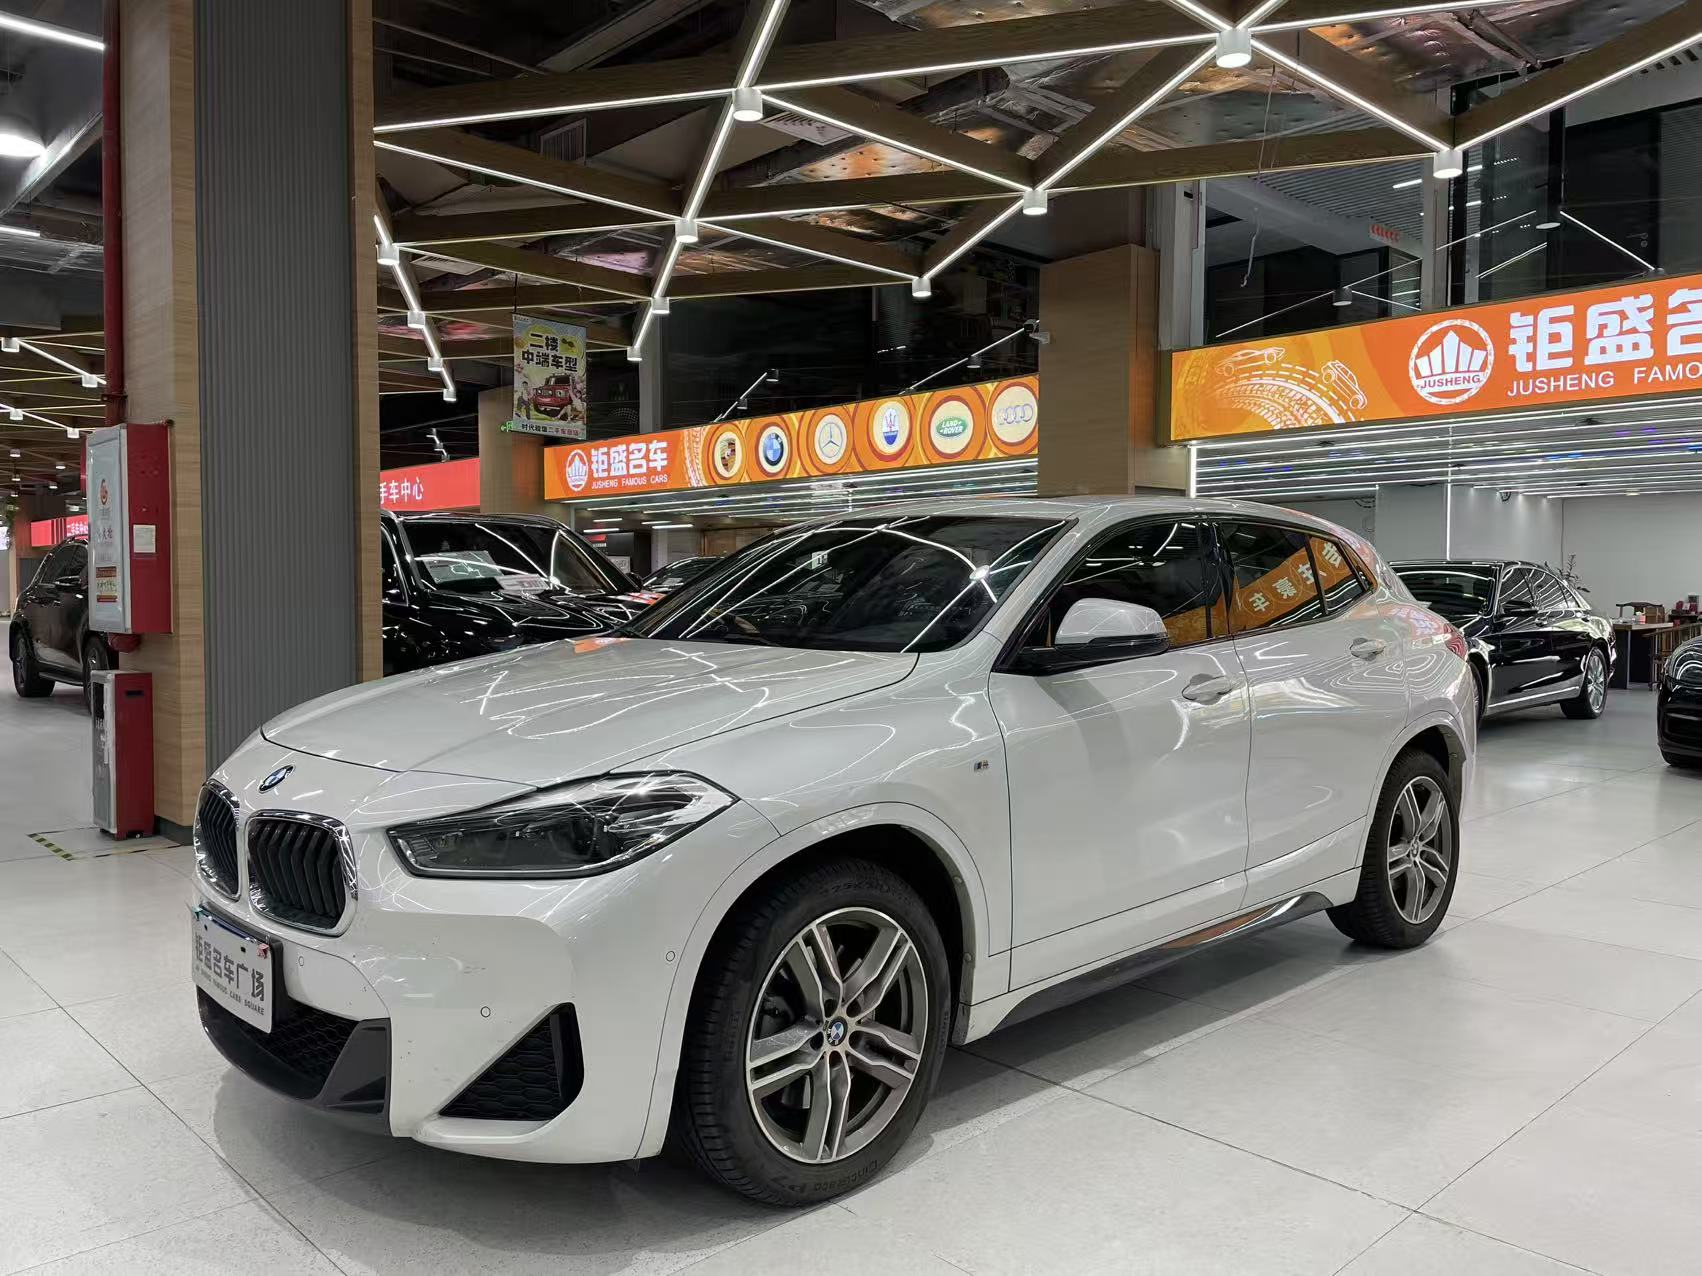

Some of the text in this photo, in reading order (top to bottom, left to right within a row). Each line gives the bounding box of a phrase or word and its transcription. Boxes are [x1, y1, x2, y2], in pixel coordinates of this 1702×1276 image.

[529, 332, 559, 353] 二楼
[521, 349, 578, 373] 中端车型
[1420, 374, 1481, 389] JUSHENG
[1507, 371, 1615, 397] JUSHENG
[942, 420, 958, 428] LAND
[943, 426, 963, 435] ROVER
[591, 439, 668, 478] 钜盛名车
[591, 478, 618, 490] JUSHENG
[621, 476, 647, 487] FAMOUS
[650, 473, 668, 484] CARS
[244, 999, 265, 1016] SQUARE
